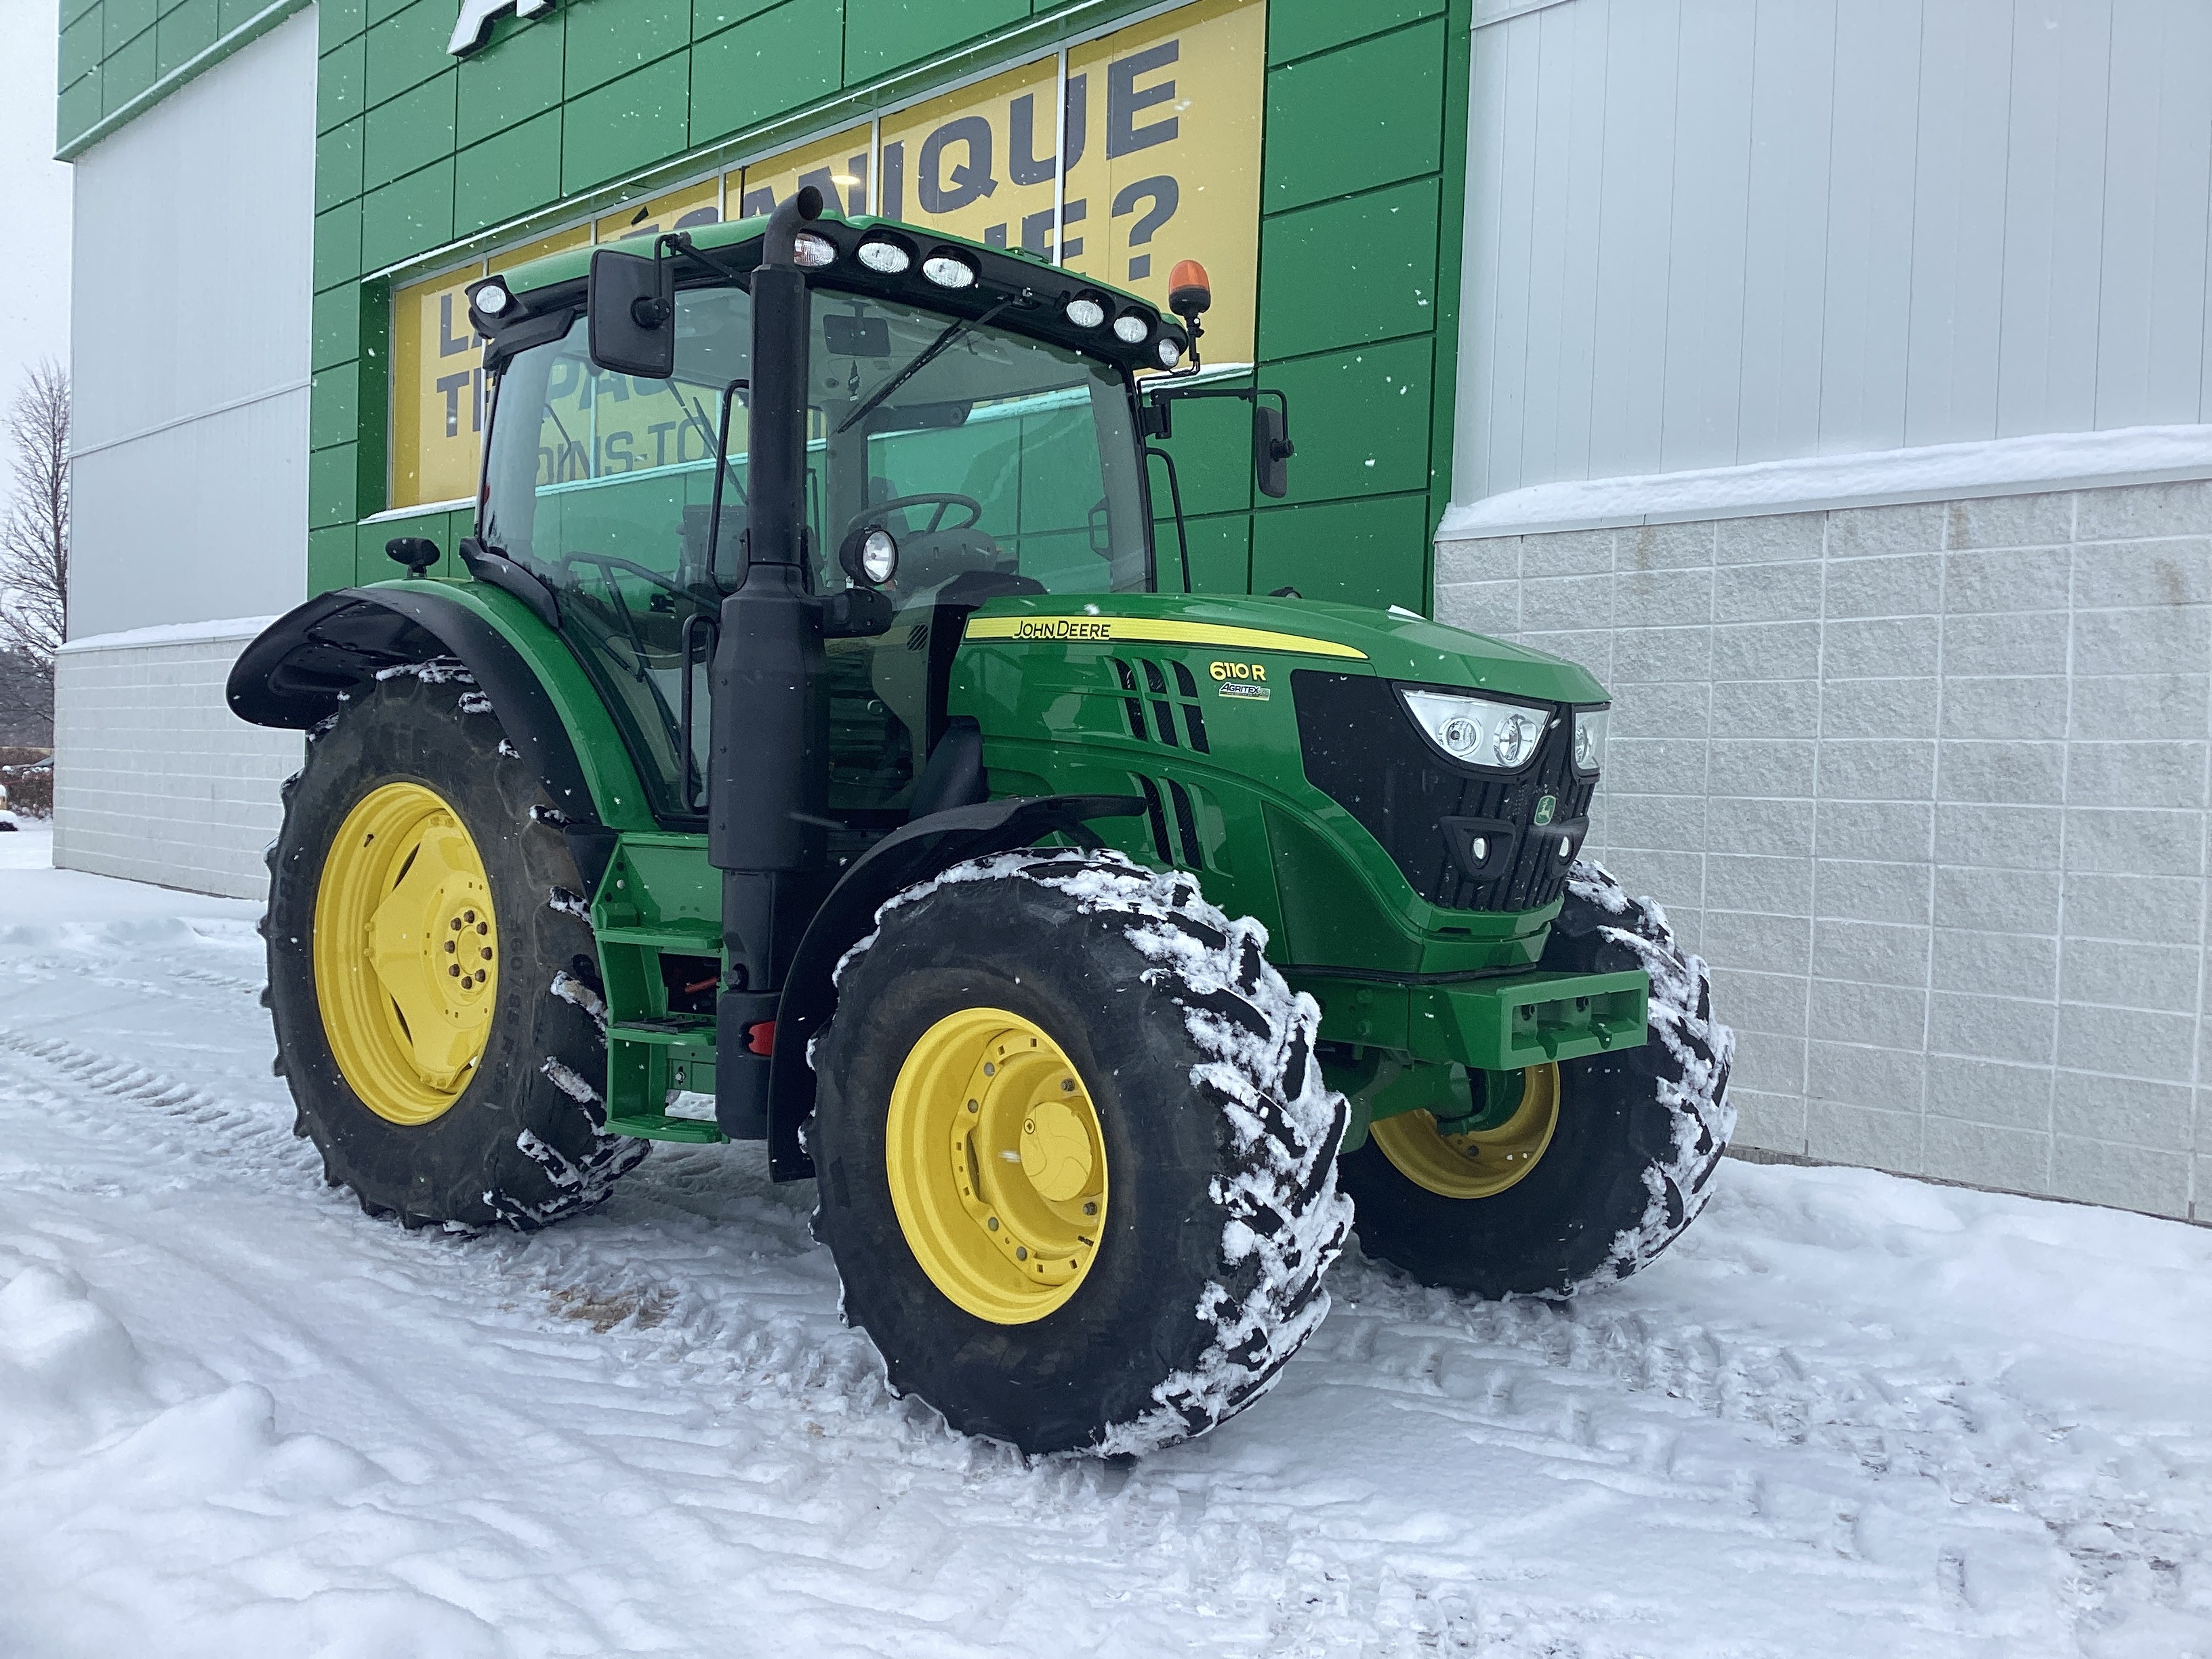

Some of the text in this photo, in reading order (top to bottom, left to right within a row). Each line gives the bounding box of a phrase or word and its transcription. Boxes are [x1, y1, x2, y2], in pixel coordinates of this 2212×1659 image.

[1014, 619, 1111, 638] JOHN DEERE
[1221, 682, 1260, 695] AGRITEX
